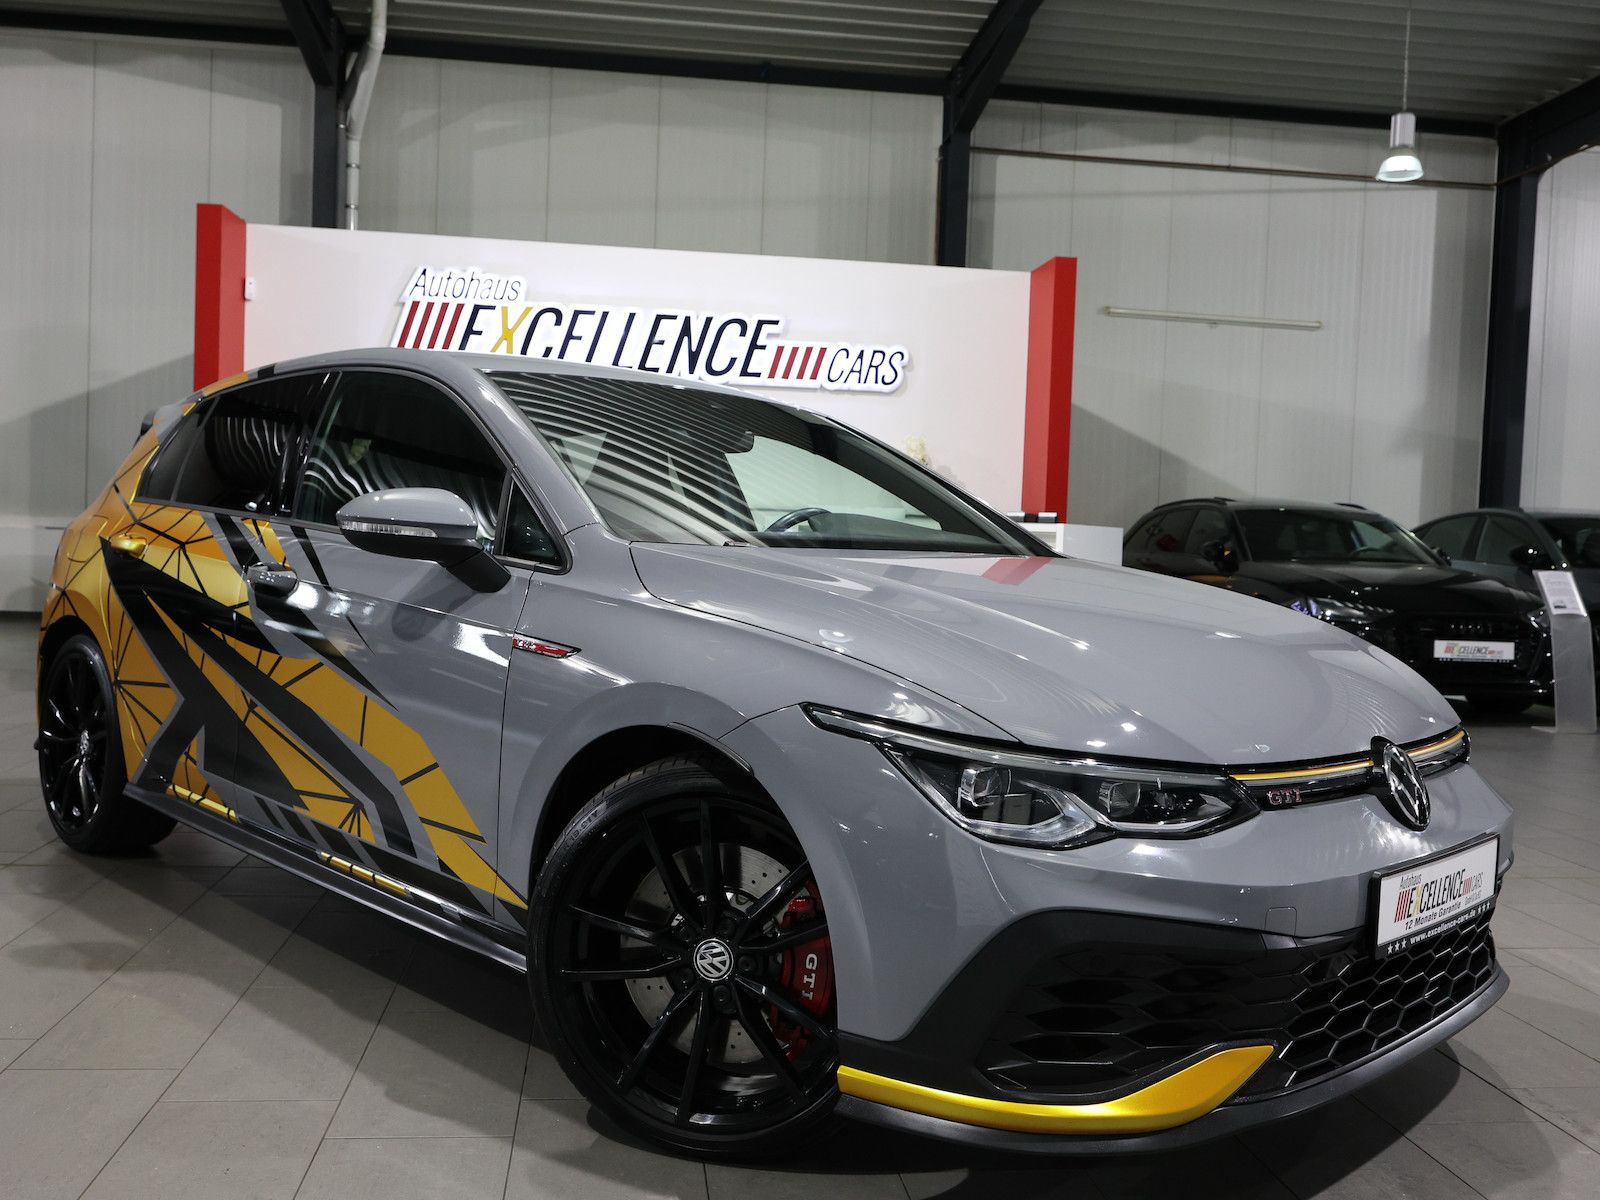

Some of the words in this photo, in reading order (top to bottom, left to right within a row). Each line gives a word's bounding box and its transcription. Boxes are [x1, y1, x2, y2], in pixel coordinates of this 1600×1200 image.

[409, 267, 522, 301] Autohaus
[458, 304, 779, 378] EXCELLENCE
[826, 347, 905, 385] CARS
[1267, 787, 1302, 806] GTI
[1400, 873, 1421, 890] Autohaus
[1407, 869, 1465, 918] EXCELLENCE
[1405, 919, 1413, 931] 12
[1414, 911, 1437, 926] Monate
[1438, 901, 1461, 917] Garantie
[1410, 909, 1476, 944] www.excellence-cars.de
[802, 953, 818, 1000] GTI
